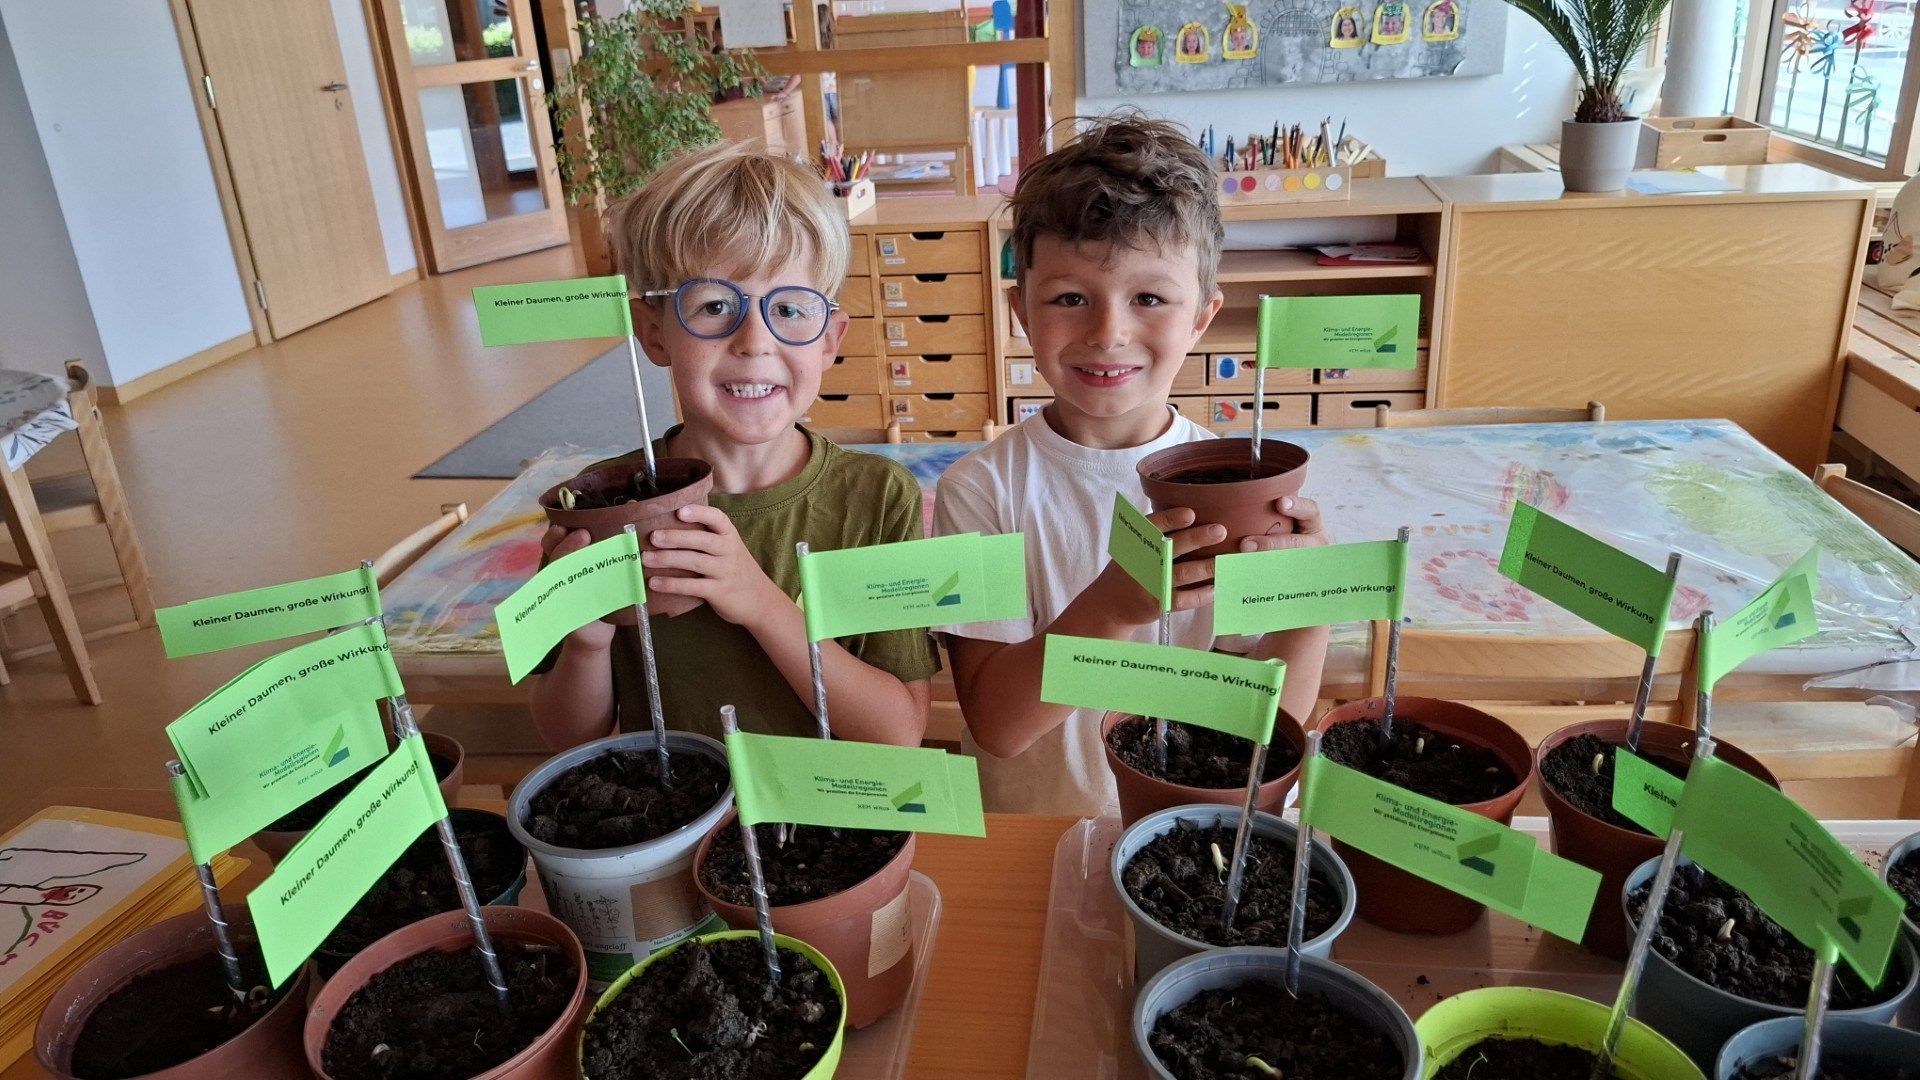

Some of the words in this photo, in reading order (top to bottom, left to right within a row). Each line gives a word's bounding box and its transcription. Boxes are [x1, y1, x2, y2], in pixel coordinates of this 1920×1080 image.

[494, 299, 524, 307] Kleiner
[526, 296, 564, 305] Daumen,
[565, 293, 589, 303] große
[591, 290, 627, 299] Wirkung
[515, 601, 537, 624] Kleiner
[537, 579, 567, 605] Daumen,
[567, 566, 594, 584] große
[866, 582, 888, 590] Klima-
[902, 577, 928, 586] Energie-
[1242, 595, 1275, 605] Kleiner
[1277, 590, 1319, 601] Daumen,
[1321, 587, 1348, 598] große
[1350, 584, 1396, 593] Wirkung!
[1525, 551, 1551, 570] Kleiner
[1552, 565, 1588, 591] Daumen,
[1588, 585, 1614, 603] große
[1615, 598, 1654, 624] Wirkung
[193, 613, 232, 628] Kleiner
[235, 605, 285, 620] Daumen,
[287, 596, 319, 613] große
[320, 585, 370, 604] Wirkung!
[1073, 654, 1118, 667] Kleiner
[1120, 659, 1177, 675] Daumen,
[1180, 668, 1219, 682] große
[208, 706, 247, 736] Kleiner
[247, 673, 297, 708] Daumen,
[298, 656, 335, 678] große
[337, 642, 389, 662] Wirkung
[259, 765, 280, 779] Klima-
[280, 756, 292, 767] und
[292, 743, 317, 760] Energie-
[814, 775, 839, 783] Klima-
[854, 778, 886, 787] Energie-
[1643, 782, 1677, 808] Kleine
[1375, 791, 1403, 807] Klima-
[1404, 804, 1421, 814] und
[1421, 808, 1459, 827] Energie-
[1392, 806, 1458, 835] Modellregionen
[280, 866, 316, 906] Kleiner
[316, 827, 356, 870] Daumen,
[356, 799, 382, 829] große
[382, 760, 419, 801] Wirkung!
